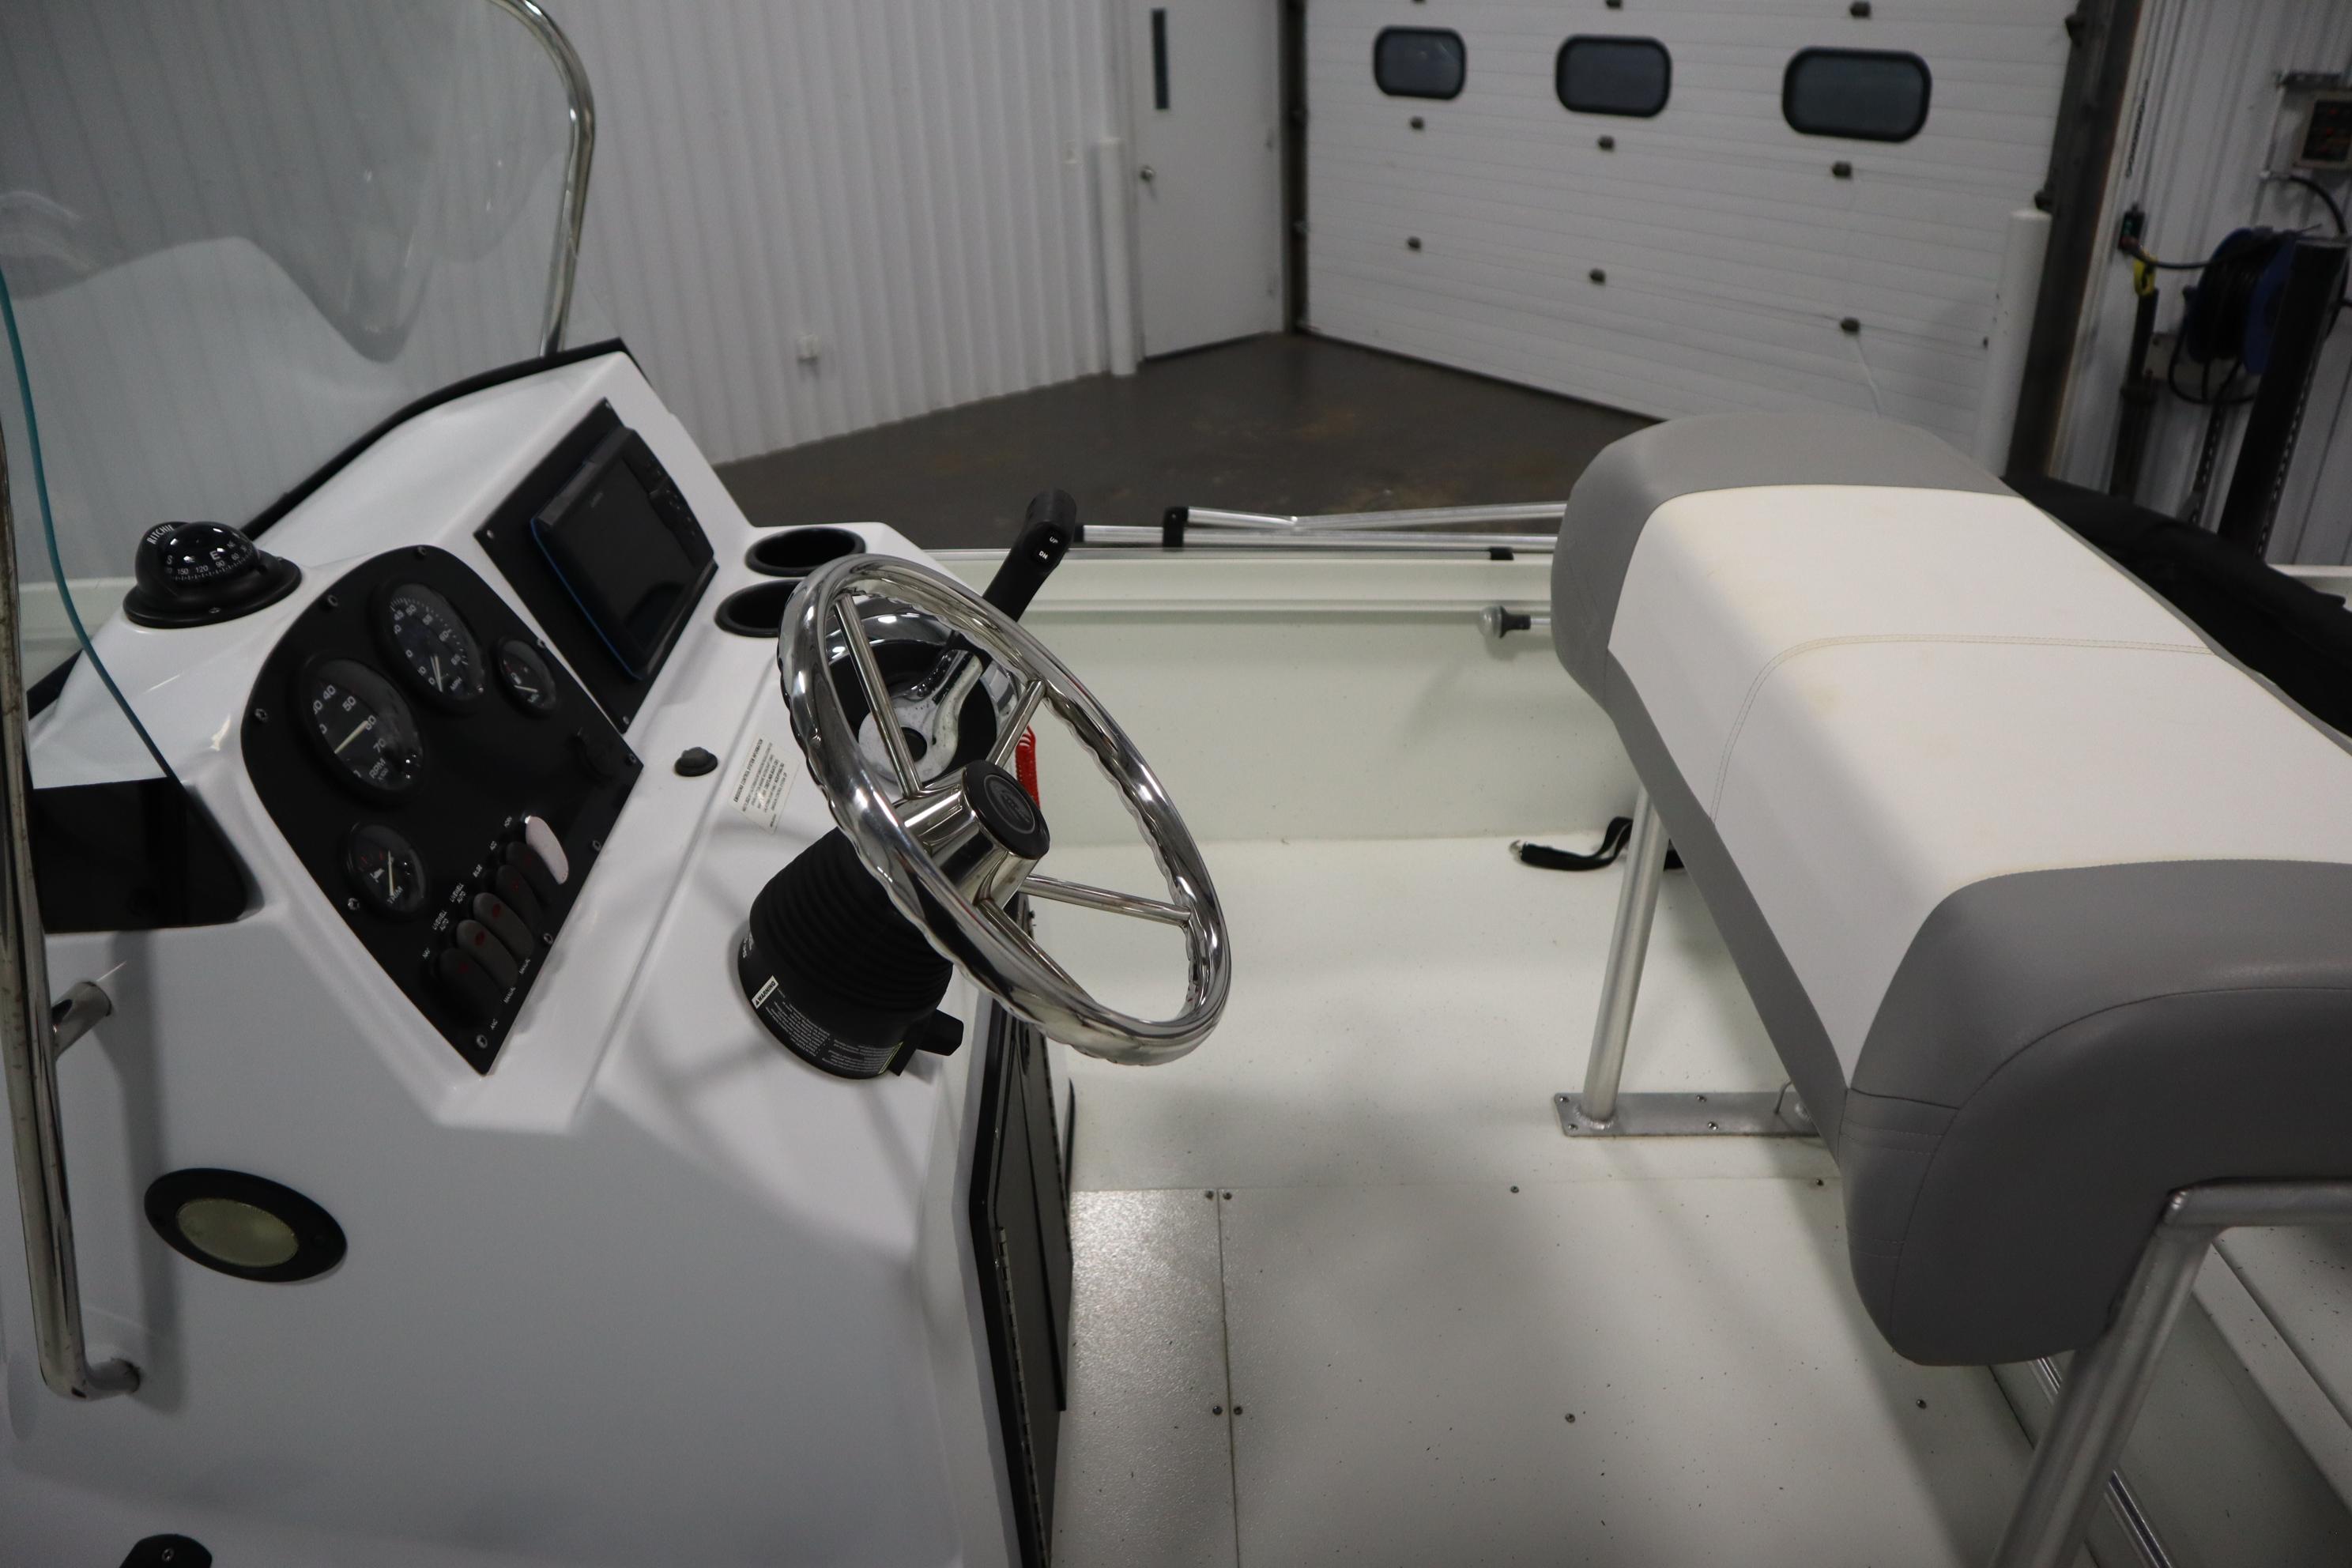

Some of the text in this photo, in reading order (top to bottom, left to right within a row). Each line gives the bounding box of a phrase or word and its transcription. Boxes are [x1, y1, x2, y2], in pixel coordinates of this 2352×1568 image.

[167, 555, 173, 564] S
[209, 551, 220, 560] E
[1038, 550, 1049, 560] DN
[215, 560, 224, 568] 90
[322, 684, 336, 700] 40
[342, 695, 356, 711] 50
[373, 737, 386, 753] 70
[369, 757, 386, 778] RPM
[758, 981, 776, 1002] WARNING
